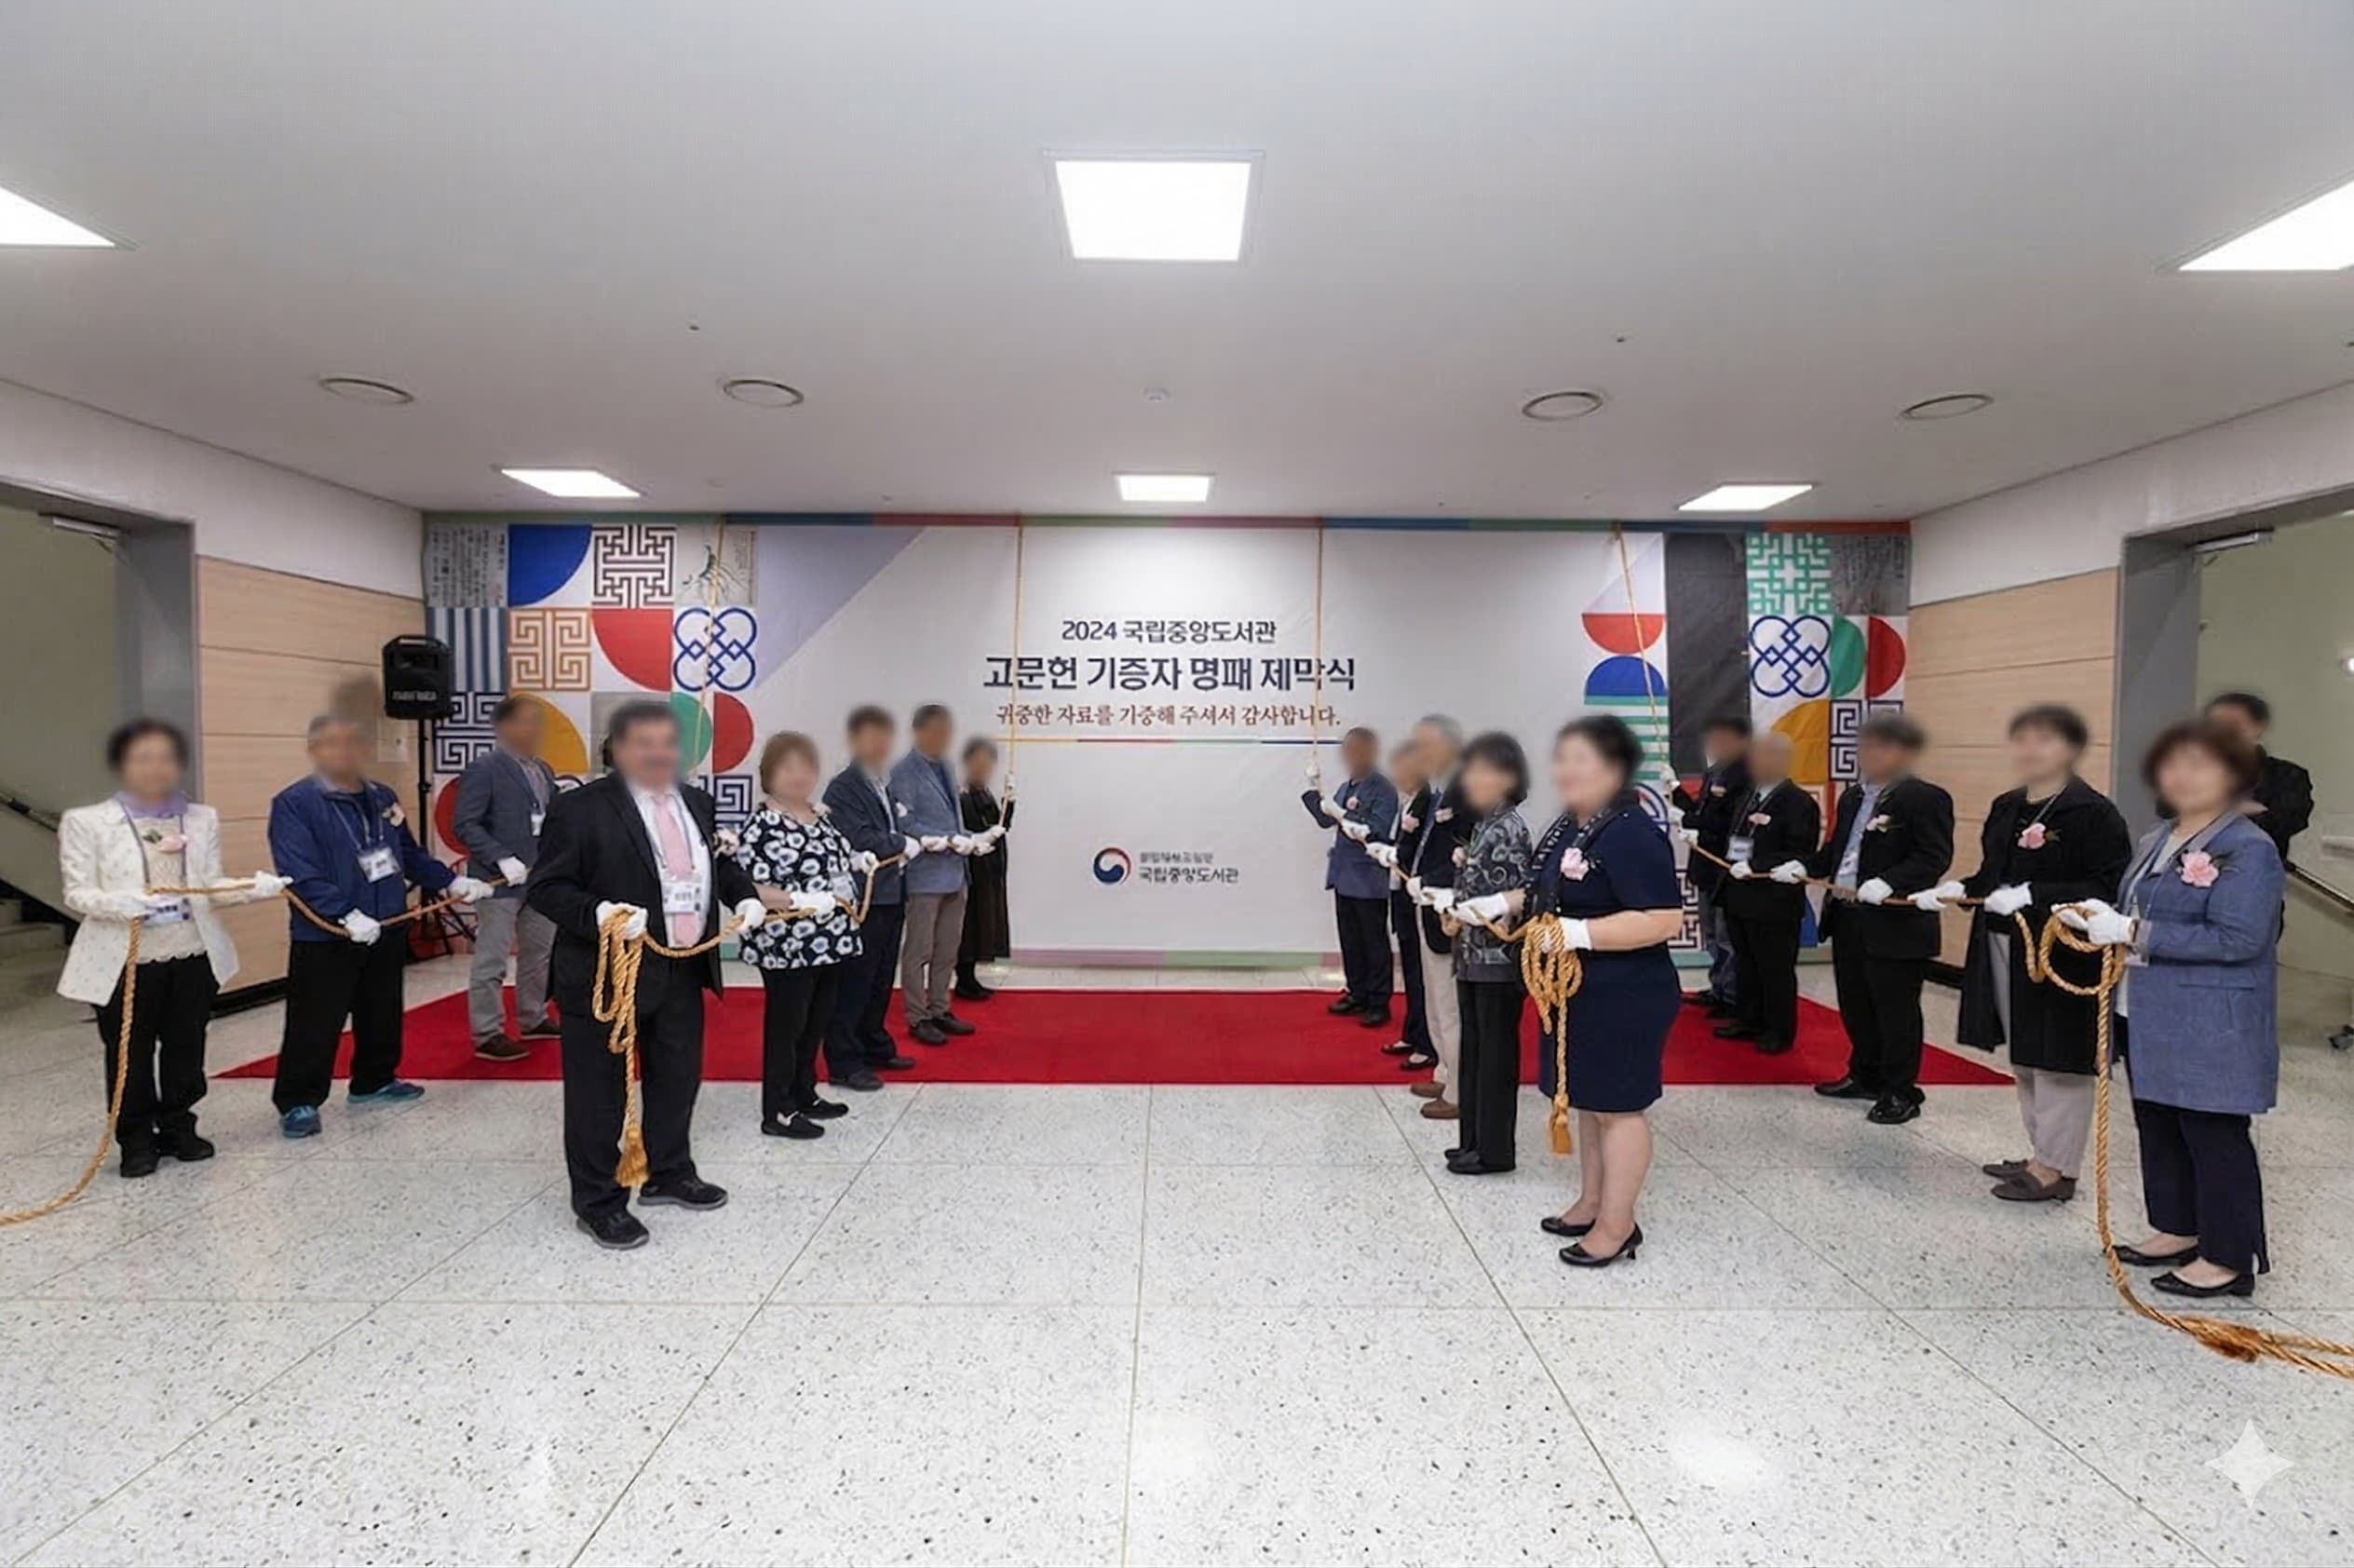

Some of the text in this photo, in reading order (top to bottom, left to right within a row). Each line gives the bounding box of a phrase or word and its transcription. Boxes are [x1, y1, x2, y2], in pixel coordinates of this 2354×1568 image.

[1062, 621, 1277, 644] 2024 국립중앙도서관
[983, 656, 1355, 691] 고문헌 기증자 명패 제막식
[1058, 704, 1114, 726] 자료를
[1241, 704, 1342, 726] 감사합니다.
[1139, 866, 1238, 884] 국립중앙도서관
